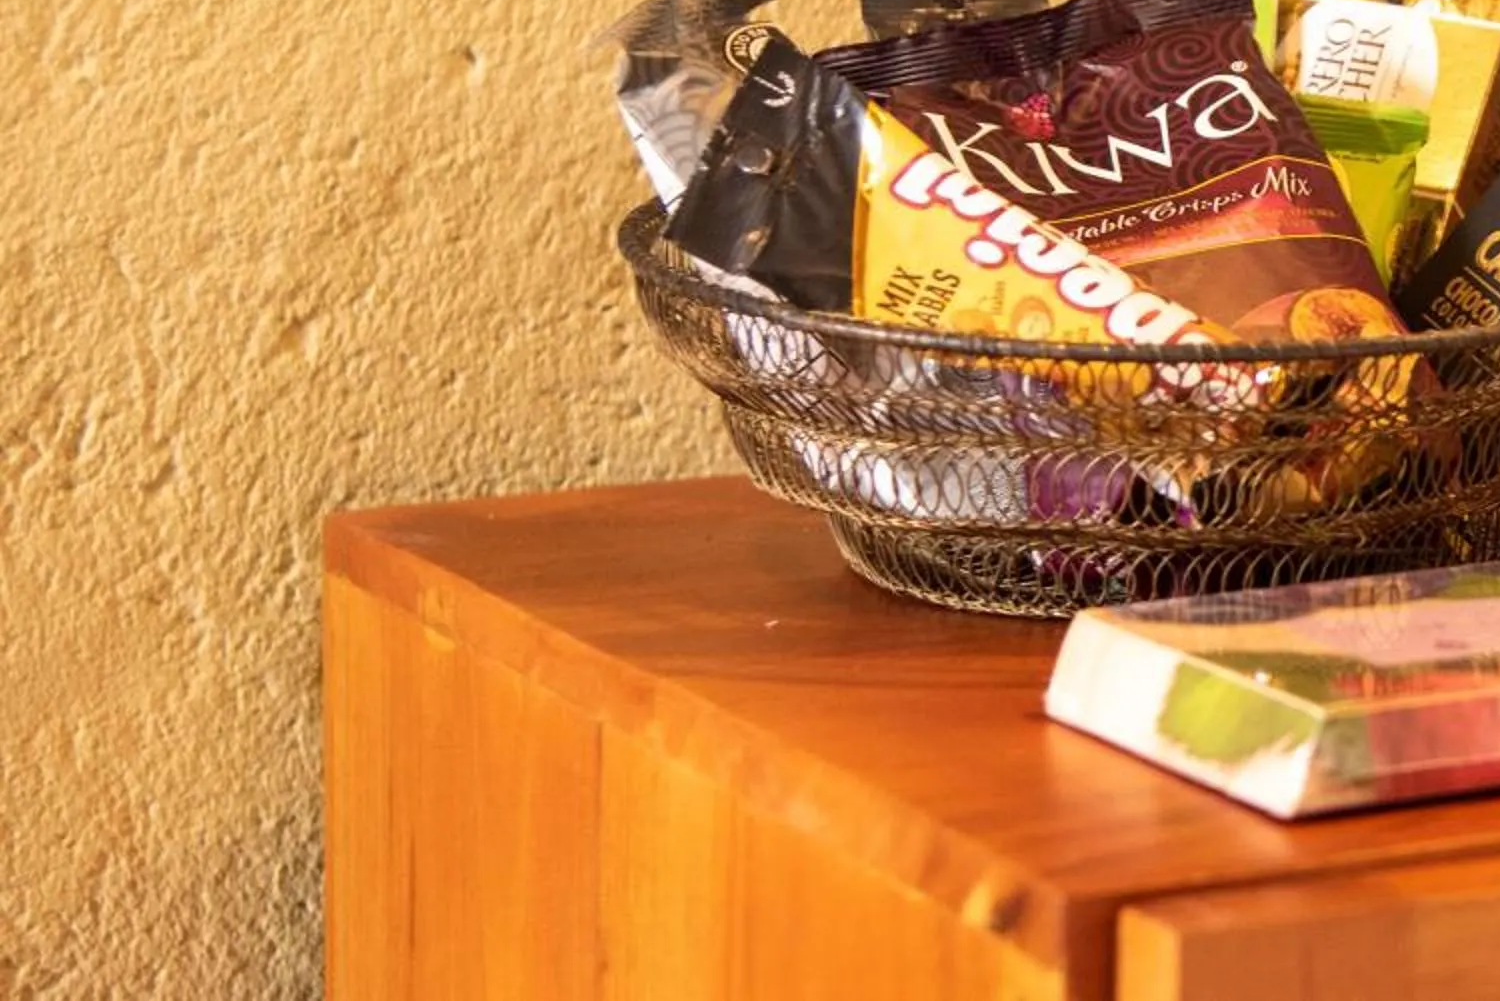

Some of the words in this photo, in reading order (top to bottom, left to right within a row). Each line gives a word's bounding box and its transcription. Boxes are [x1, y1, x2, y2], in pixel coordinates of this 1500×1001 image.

[1142, 190, 1244, 222] Crisps
[1250, 165, 1312, 202] Mix
[876, 265, 926, 318] MIX
